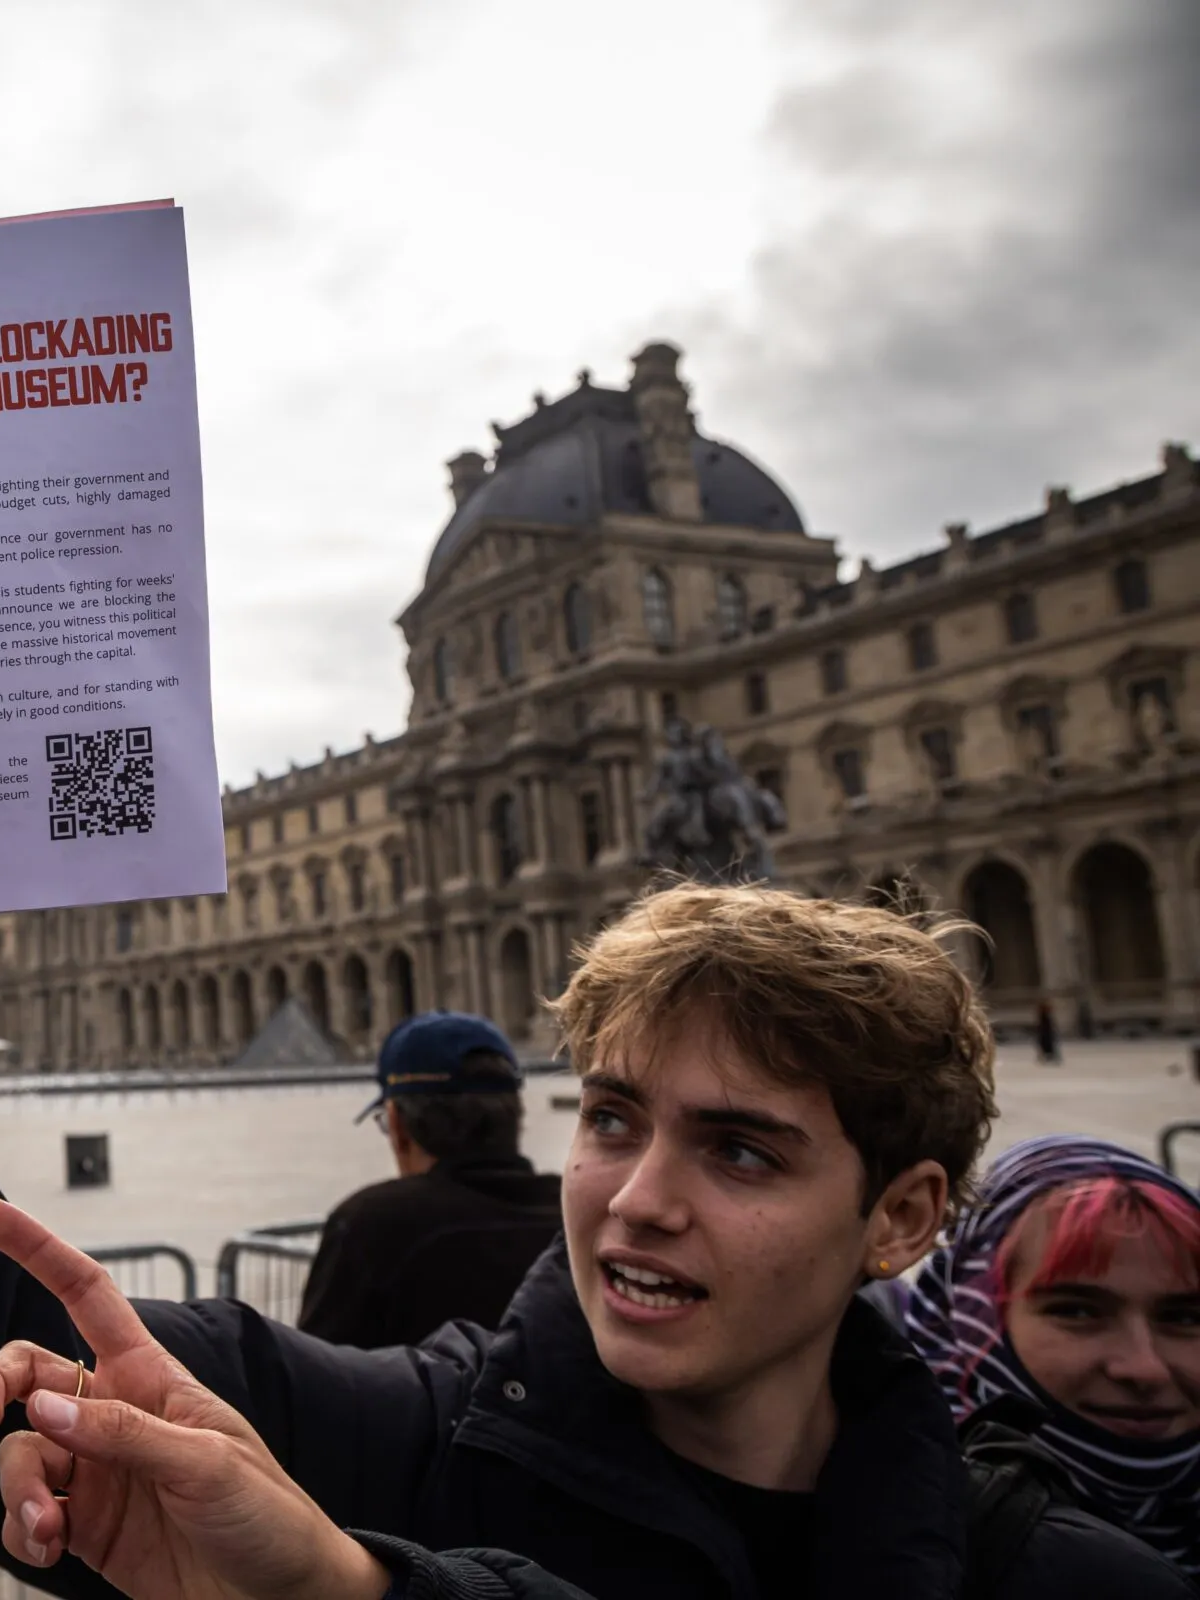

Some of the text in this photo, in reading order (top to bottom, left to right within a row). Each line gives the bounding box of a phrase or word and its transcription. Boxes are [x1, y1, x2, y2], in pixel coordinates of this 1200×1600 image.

[42, 476, 71, 489] their
[73, 472, 146, 489] government
[148, 469, 169, 482] and
[42, 495, 70, 506] cuts,
[76, 490, 111, 506] highly
[117, 486, 171, 502] damaged
[27, 532, 49, 543] our
[54, 526, 125, 544] government
[131, 524, 152, 535] has
[158, 524, 173, 533] no
[20, 547, 55, 564] police
[58, 543, 122, 560] repression.
[0, 586, 10, 598] is
[14, 583, 66, 597] students
[69, 579, 113, 592] fighting
[115, 576, 133, 588] for
[136, 573, 175, 587] weeks'
[58, 600, 76, 610] we
[80, 598, 100, 609] are
[104, 593, 152, 607] blocking
[156, 591, 176, 603] the
[38, 619, 61, 633] you
[63, 615, 107, 628] witness
[109, 611, 130, 624] this
[132, 607, 176, 625] political
[11, 636, 59, 649] massive
[62, 629, 114, 645] historical
[117, 626, 177, 640] movement
[24, 651, 72, 666] through
[74, 649, 94, 661] the
[96, 644, 136, 661] capital.
[8, 689, 53, 702] culture,
[56, 684, 79, 697] and
[83, 683, 101, 695] for
[104, 679, 153, 693] standing
[156, 675, 179, 688] with
[16, 707, 27, 718] in
[29, 703, 60, 720] good
[62, 700, 126, 714] conditions.
[8, 756, 28, 767] the
